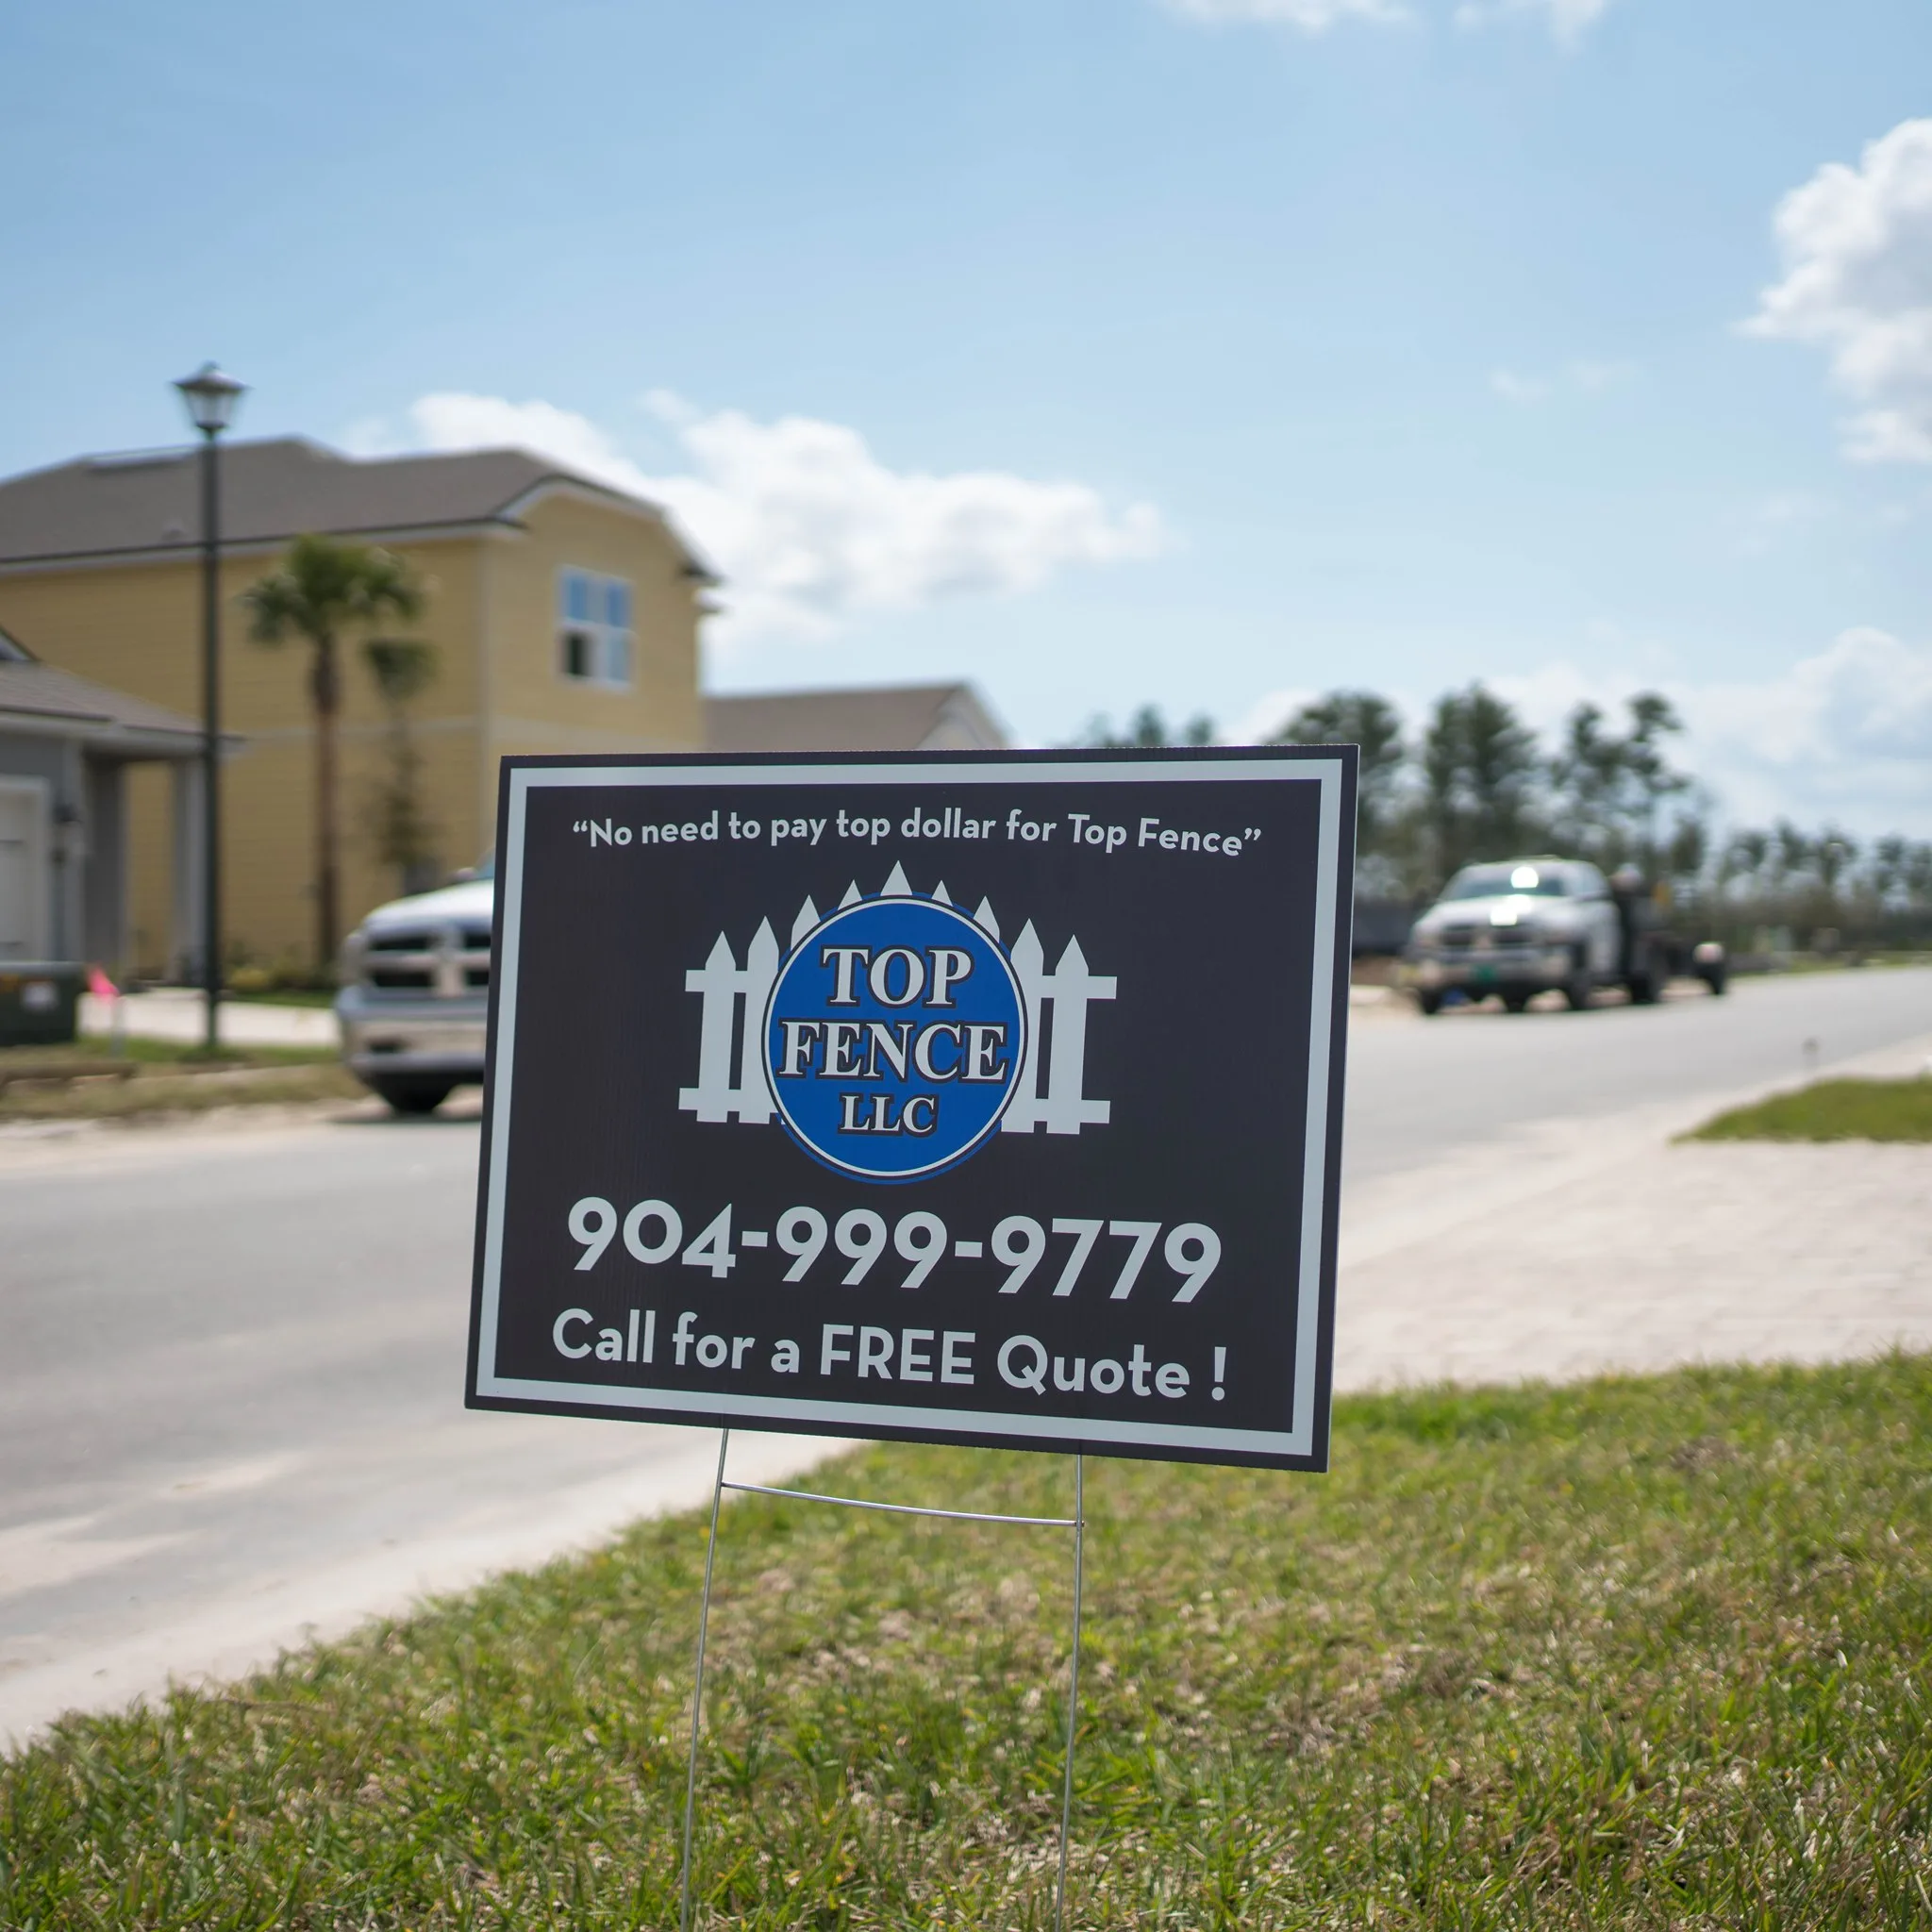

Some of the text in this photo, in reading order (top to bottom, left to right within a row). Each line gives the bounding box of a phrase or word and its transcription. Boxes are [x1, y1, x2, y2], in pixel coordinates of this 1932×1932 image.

[574, 808, 1260, 856] “No need to pay top dollar for Top Fence”
[824, 948, 972, 1006] TOP
[779, 1021, 1007, 1080] FENCE
[841, 1095, 936, 1134] LLC
[569, 1197, 1221, 1302] 904-999-9779
[553, 1308, 1226, 1400] Call for a FREE Quote !
